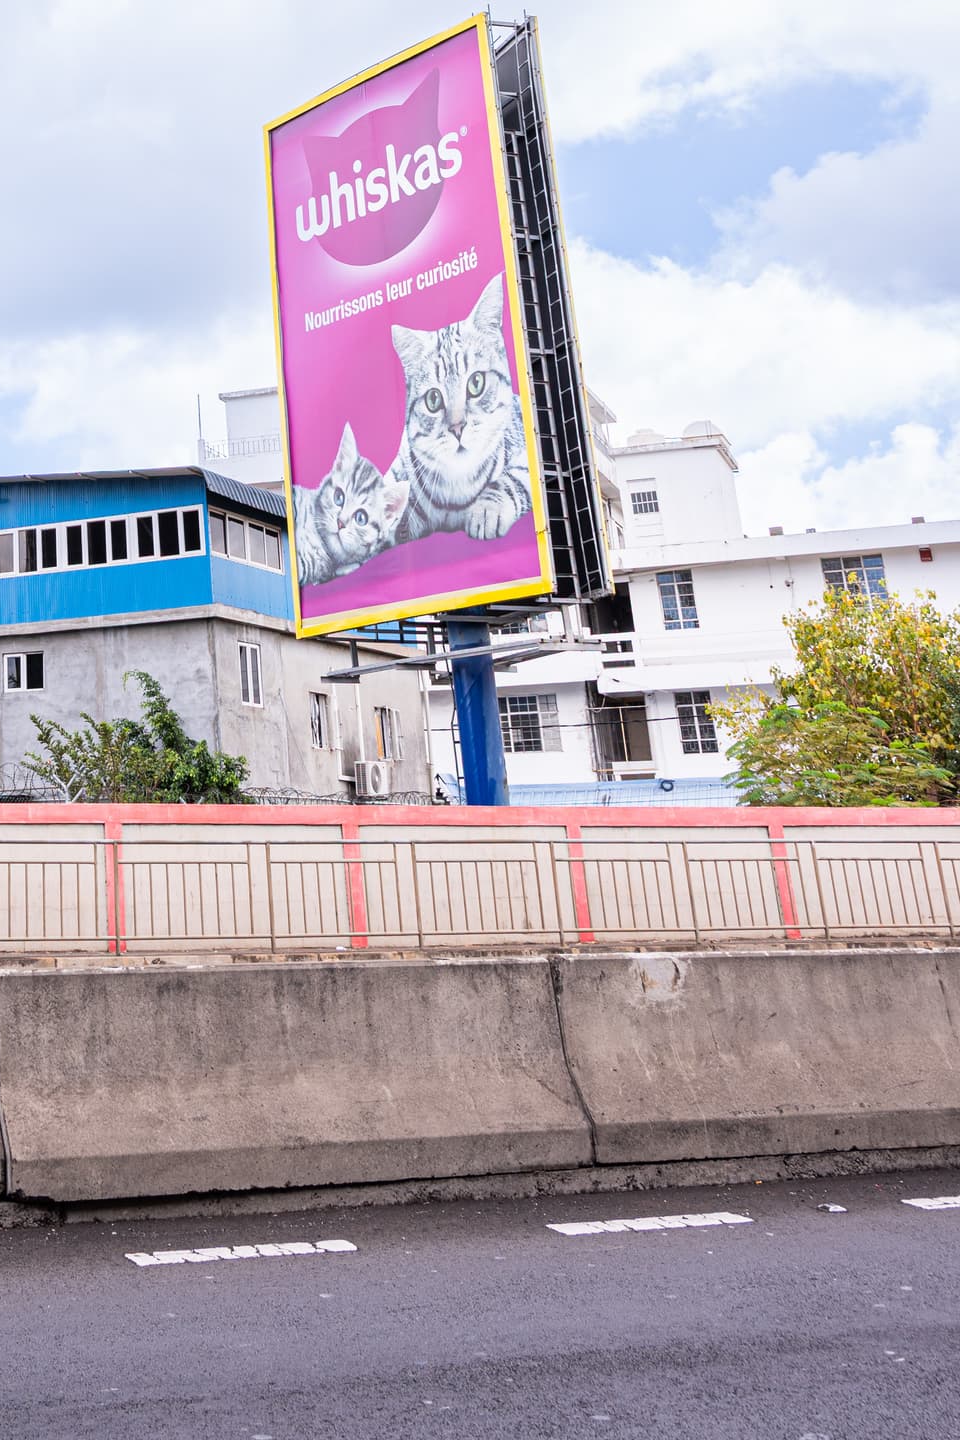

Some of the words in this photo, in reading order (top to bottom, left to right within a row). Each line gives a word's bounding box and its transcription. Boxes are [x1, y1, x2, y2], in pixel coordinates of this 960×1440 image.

[295, 131, 463, 242] whiskas
[304, 289, 384, 333] Nourrissons
[385, 277, 414, 303] leur
[416, 246, 479, 291] curiosité
